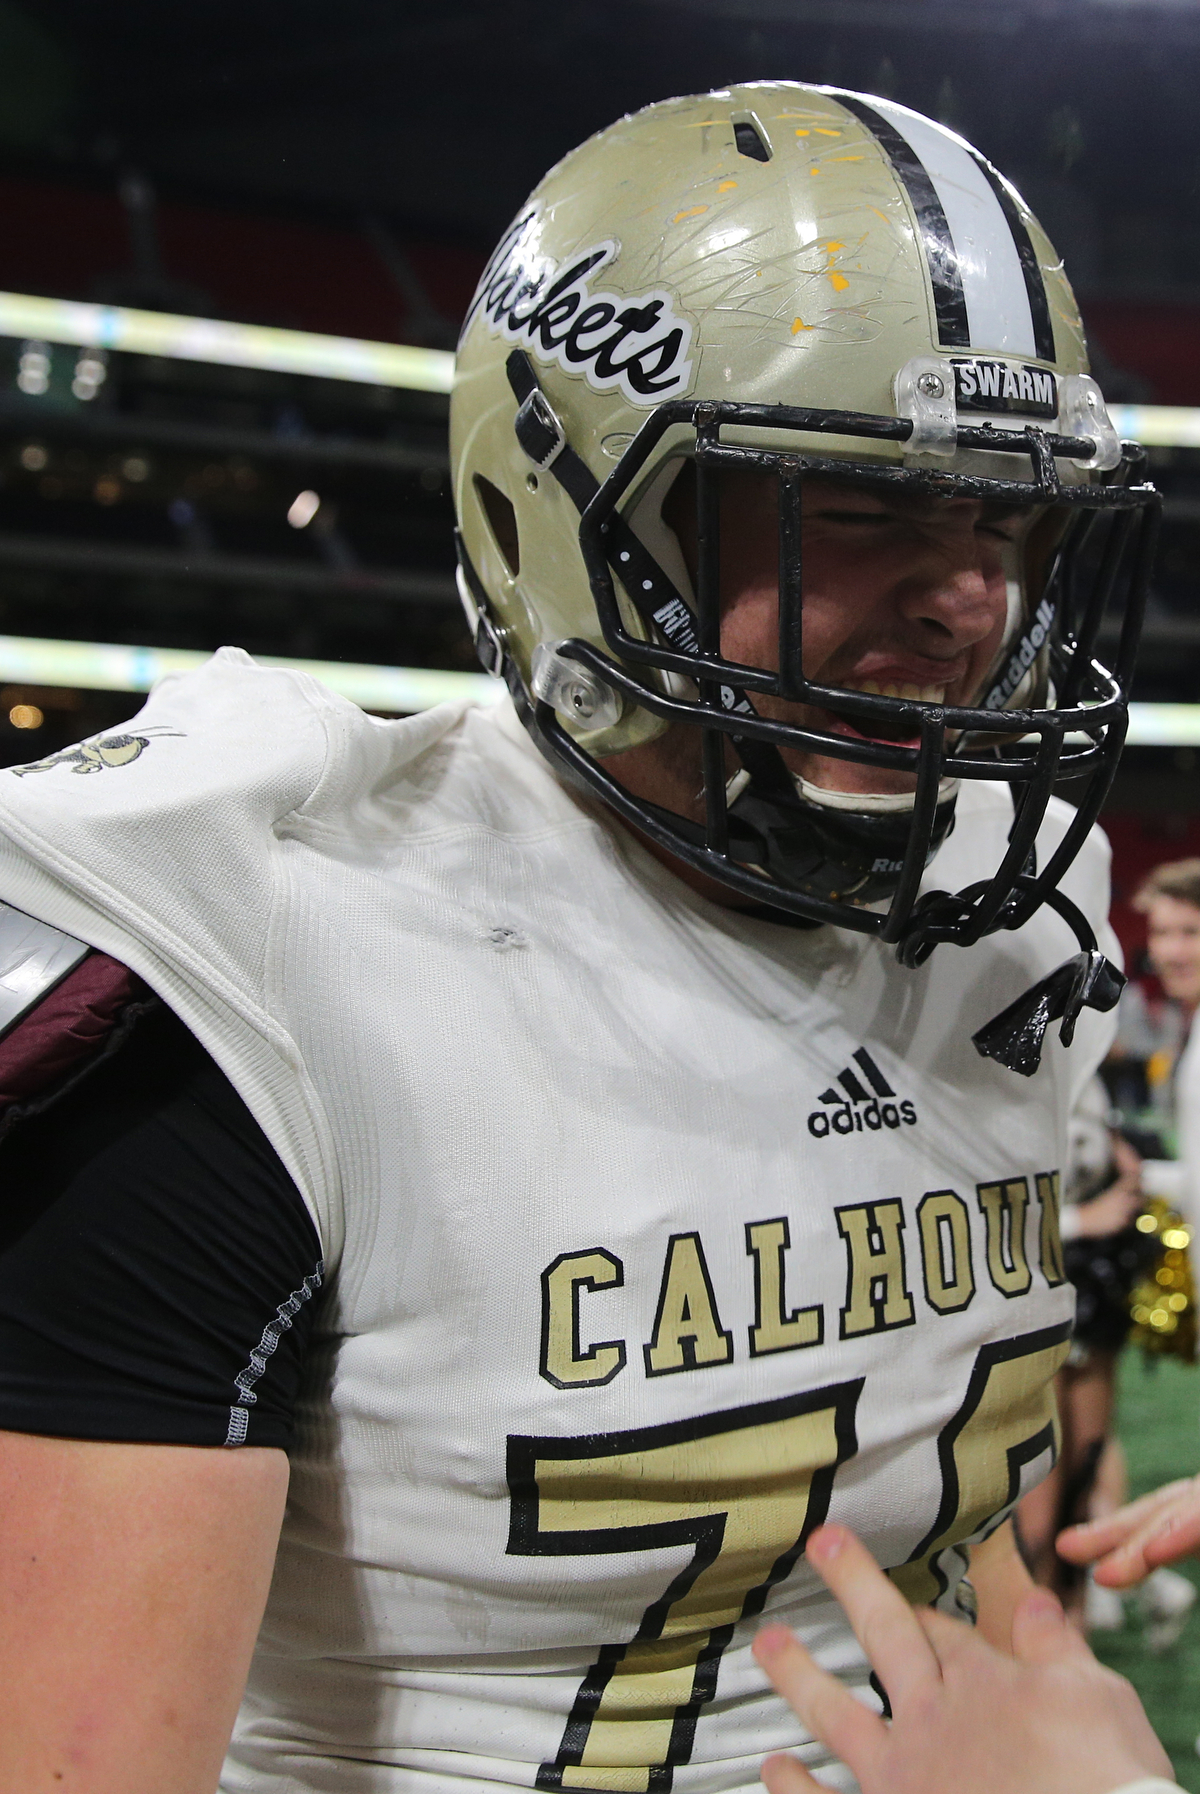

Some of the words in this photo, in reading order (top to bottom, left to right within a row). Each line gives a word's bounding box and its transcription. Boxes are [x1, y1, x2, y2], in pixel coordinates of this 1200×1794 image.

[960, 365, 1054, 405] SWARM
[985, 599, 1053, 709] Riddell
[807, 1098, 917, 1138] adidas
